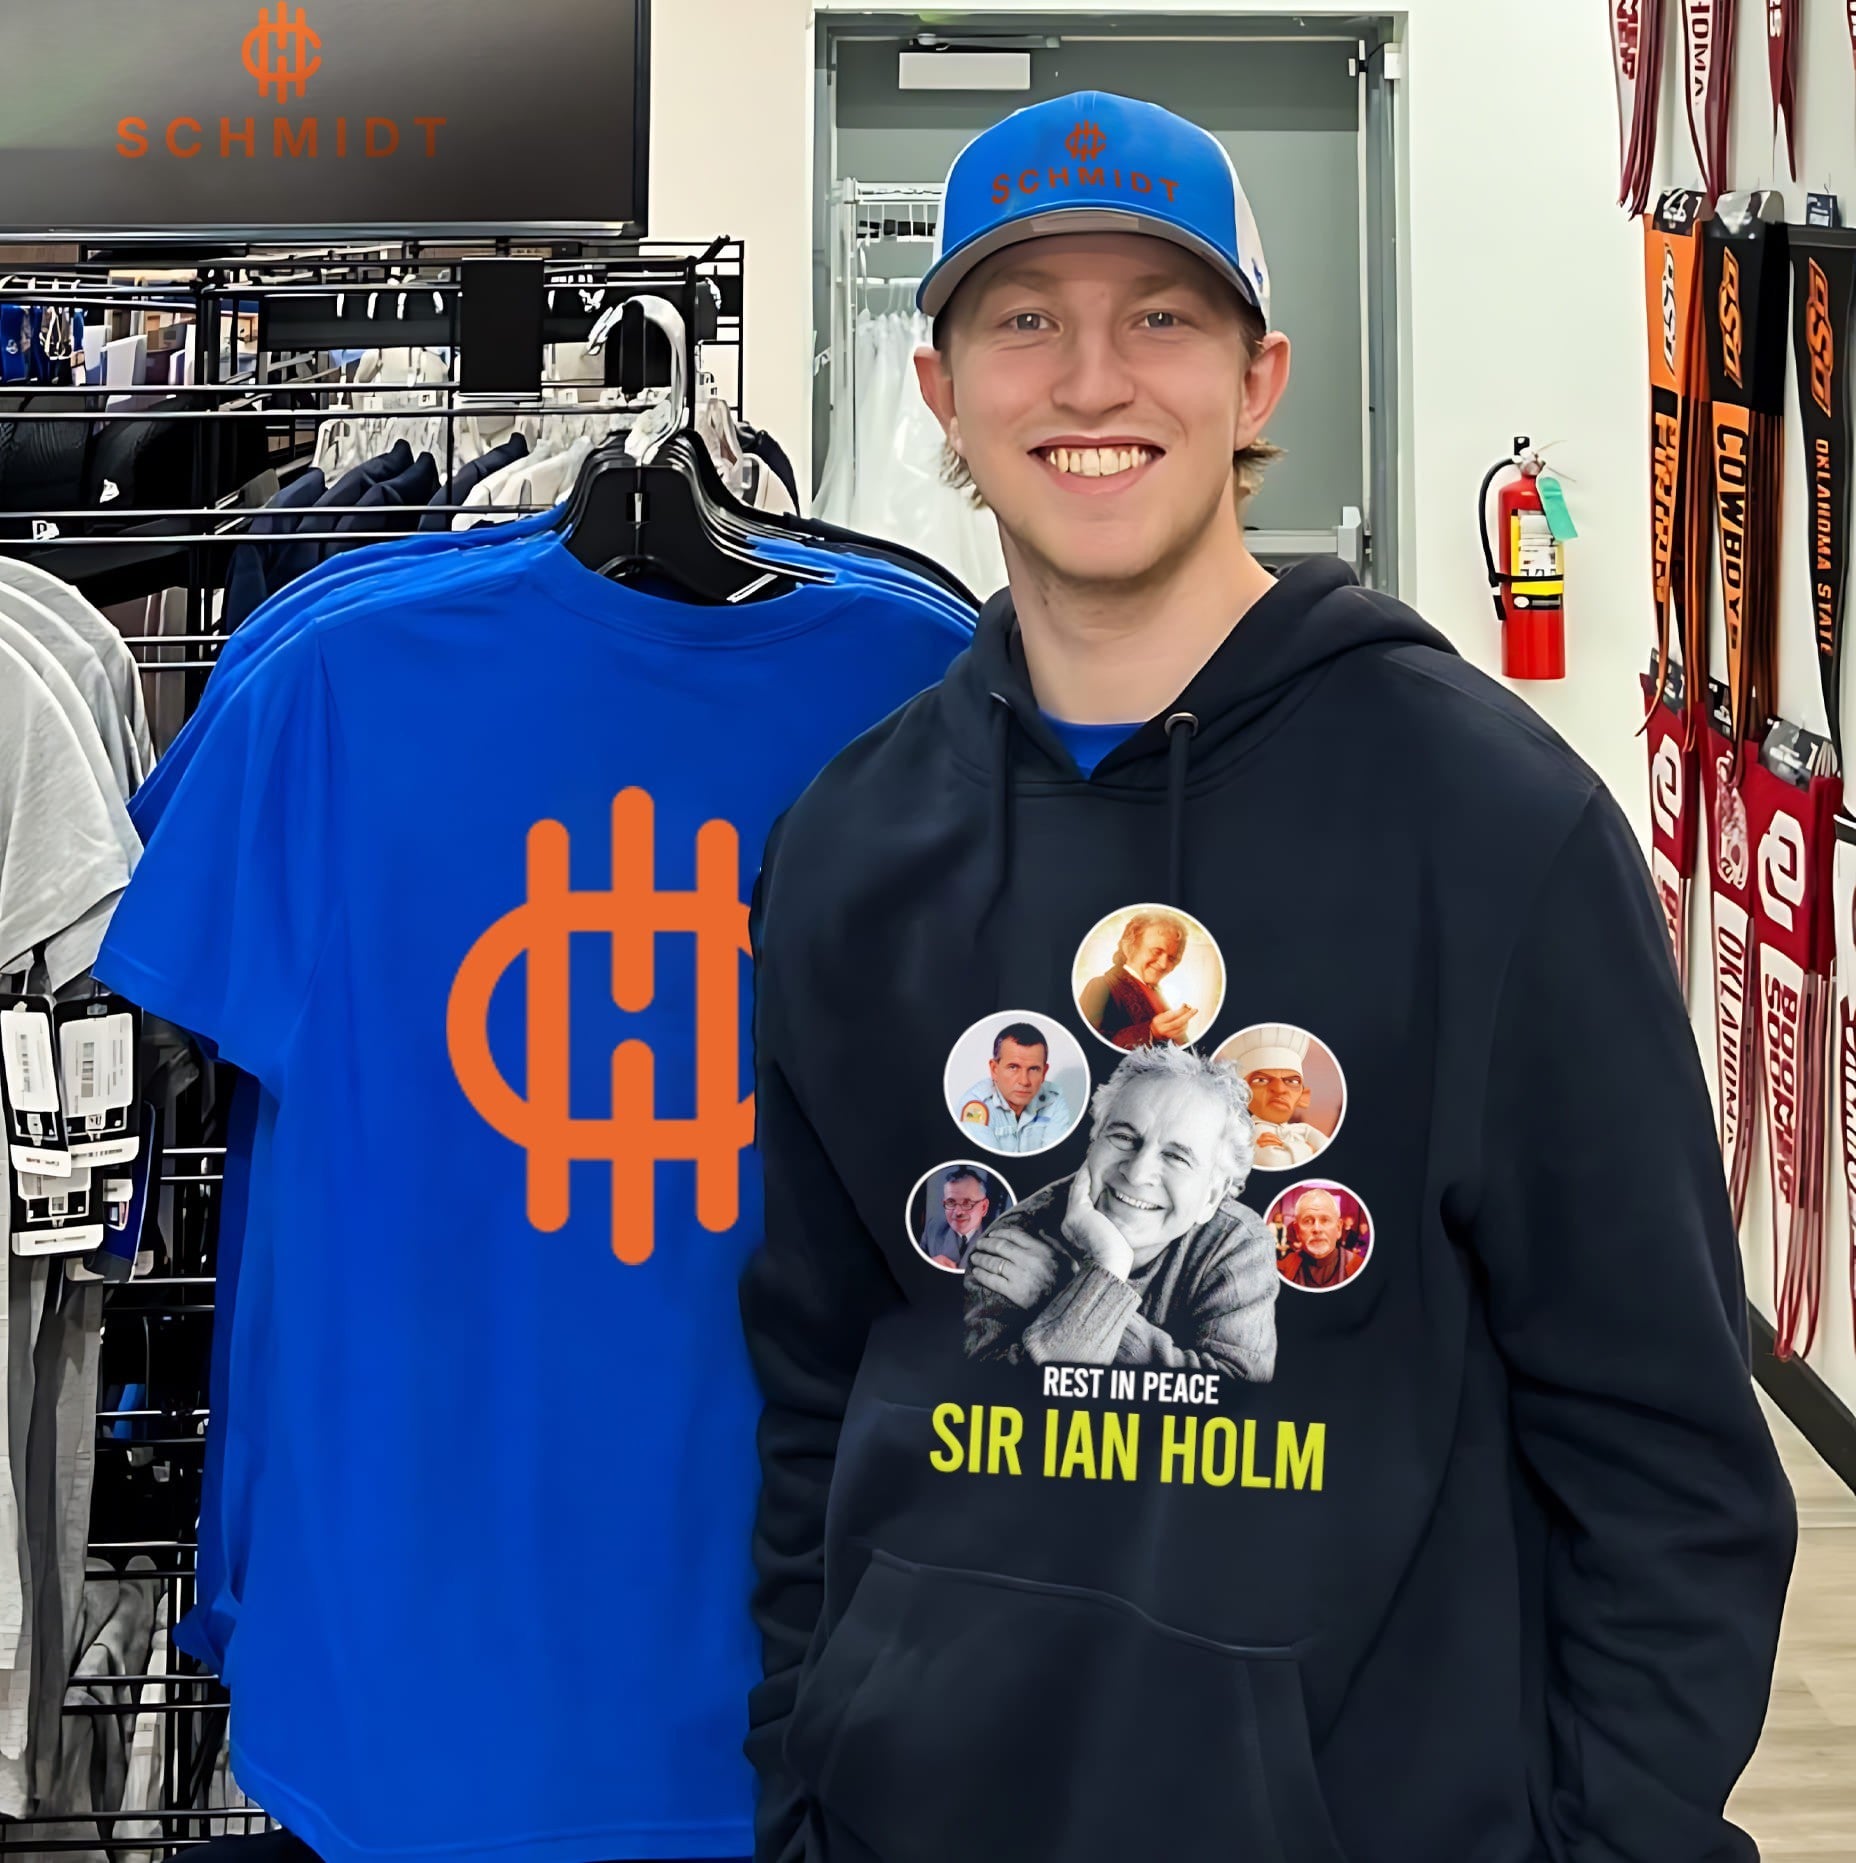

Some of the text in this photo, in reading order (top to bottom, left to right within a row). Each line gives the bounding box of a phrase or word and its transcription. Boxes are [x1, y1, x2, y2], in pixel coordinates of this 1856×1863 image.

[115, 116, 447, 158] SCHMIDT
[991, 166, 1179, 205] SCHMIDT
[1815, 439, 1832, 657] OKLAHOMA STATE
[1718, 926, 1744, 1144] OKLAHOMA
[1043, 1366, 1220, 1405] REST IN PEACE
[929, 1402, 1327, 1492] SIR IAN HOLM
